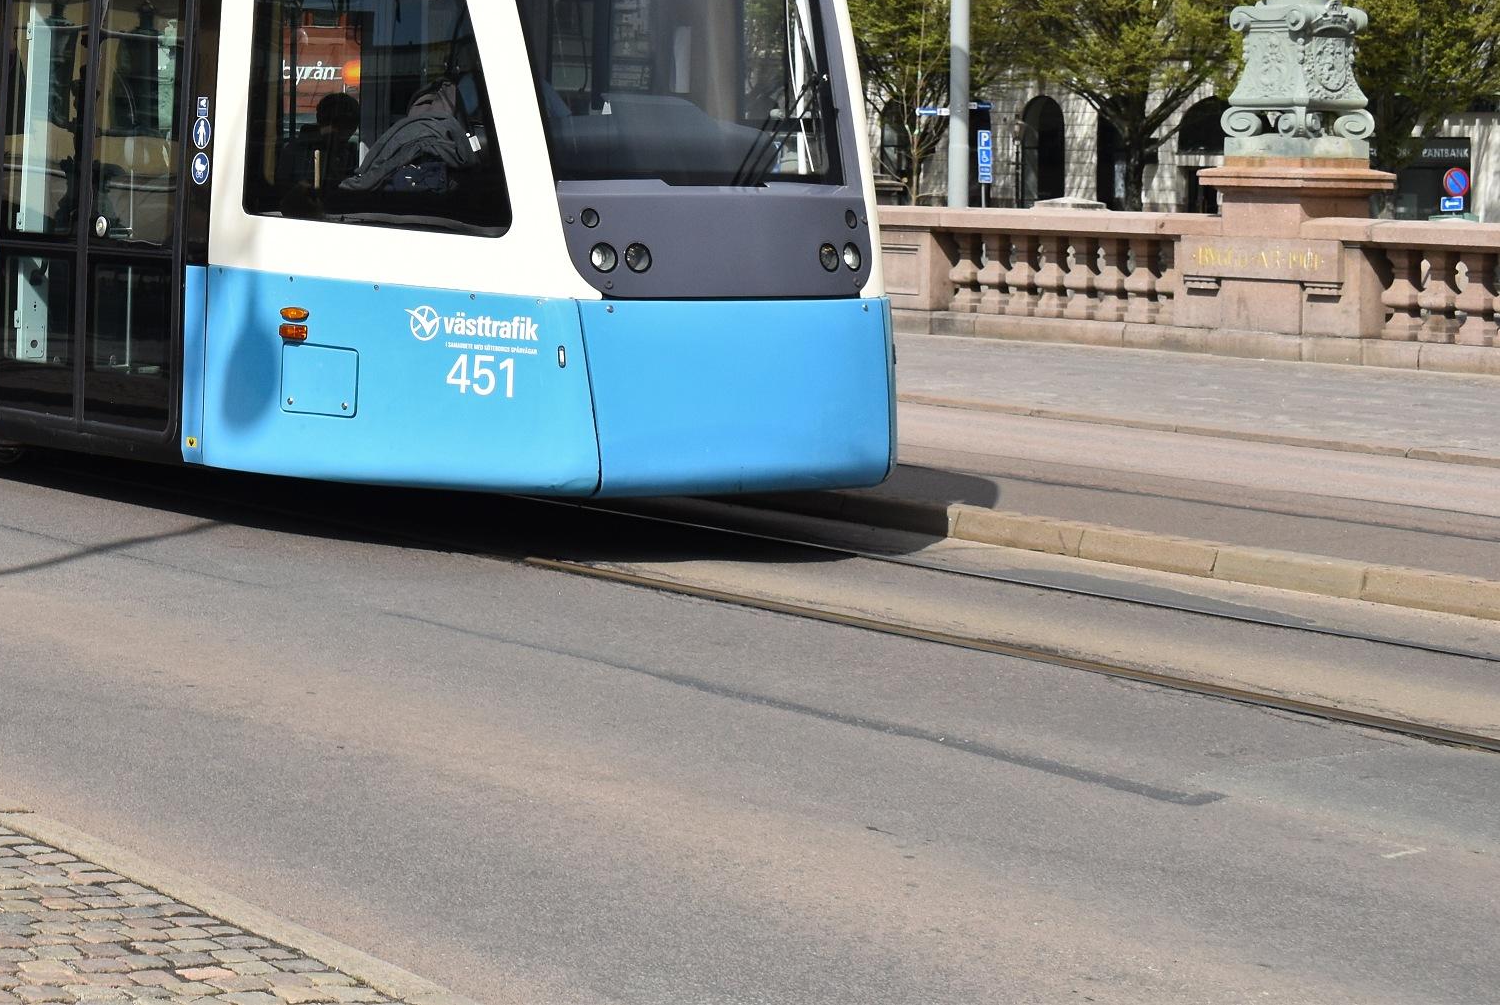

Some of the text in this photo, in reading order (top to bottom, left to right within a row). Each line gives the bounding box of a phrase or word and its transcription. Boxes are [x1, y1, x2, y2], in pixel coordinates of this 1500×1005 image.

[981, 132, 989, 147] P
[443, 311, 539, 341] västtrafik
[446, 353, 514, 398] 451
